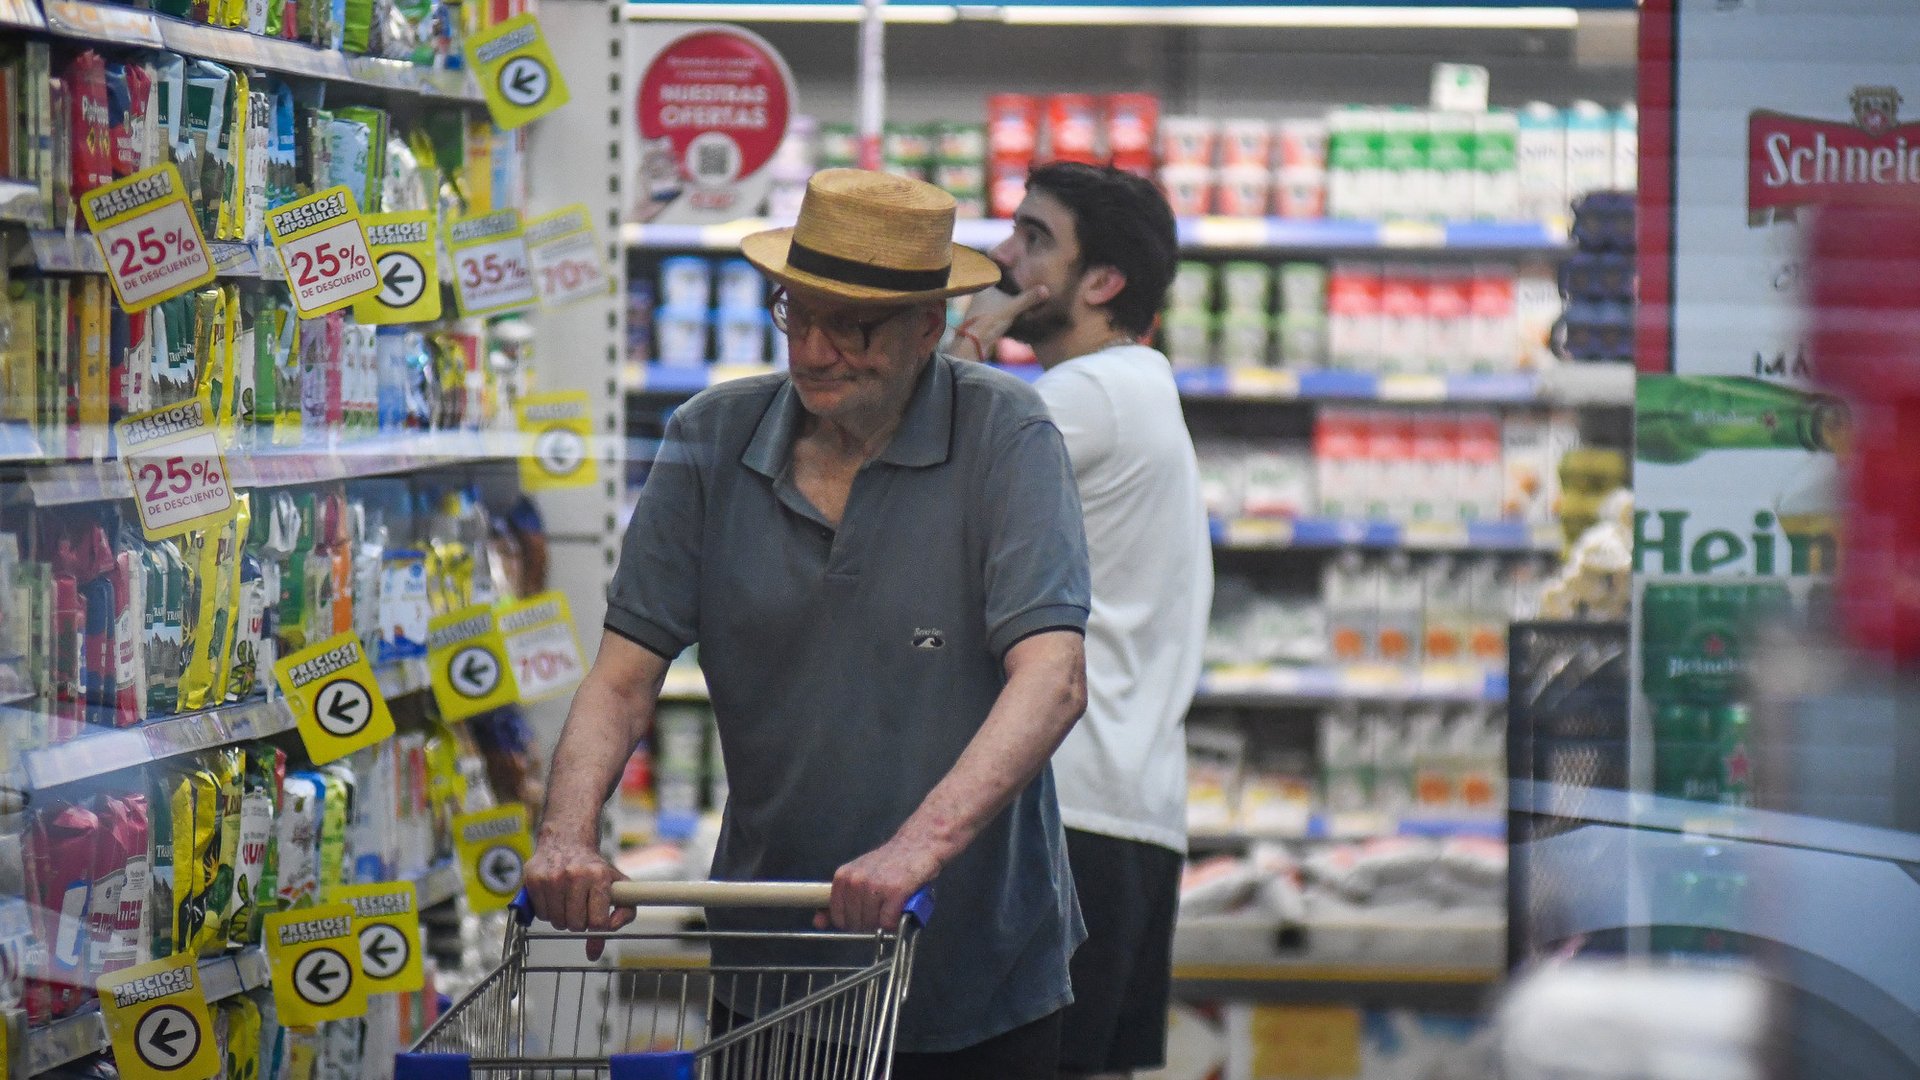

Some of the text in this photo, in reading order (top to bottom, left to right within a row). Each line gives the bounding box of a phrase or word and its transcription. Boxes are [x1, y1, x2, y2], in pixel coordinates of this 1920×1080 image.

[660, 105, 768, 129] OFERTAS
[111, 227, 195, 277] 25%
[291, 242, 366, 287] 25%
[462, 253, 527, 289] 35%
[124, 280, 138, 291] DE
[140, 253, 201, 285] DESCUENTO
[302, 267, 371, 299] DE DESCUENTO
[139, 456, 219, 502] 25%
[148, 487, 224, 515] DE DESCUENTO
[1632, 510, 1838, 576] Hein
